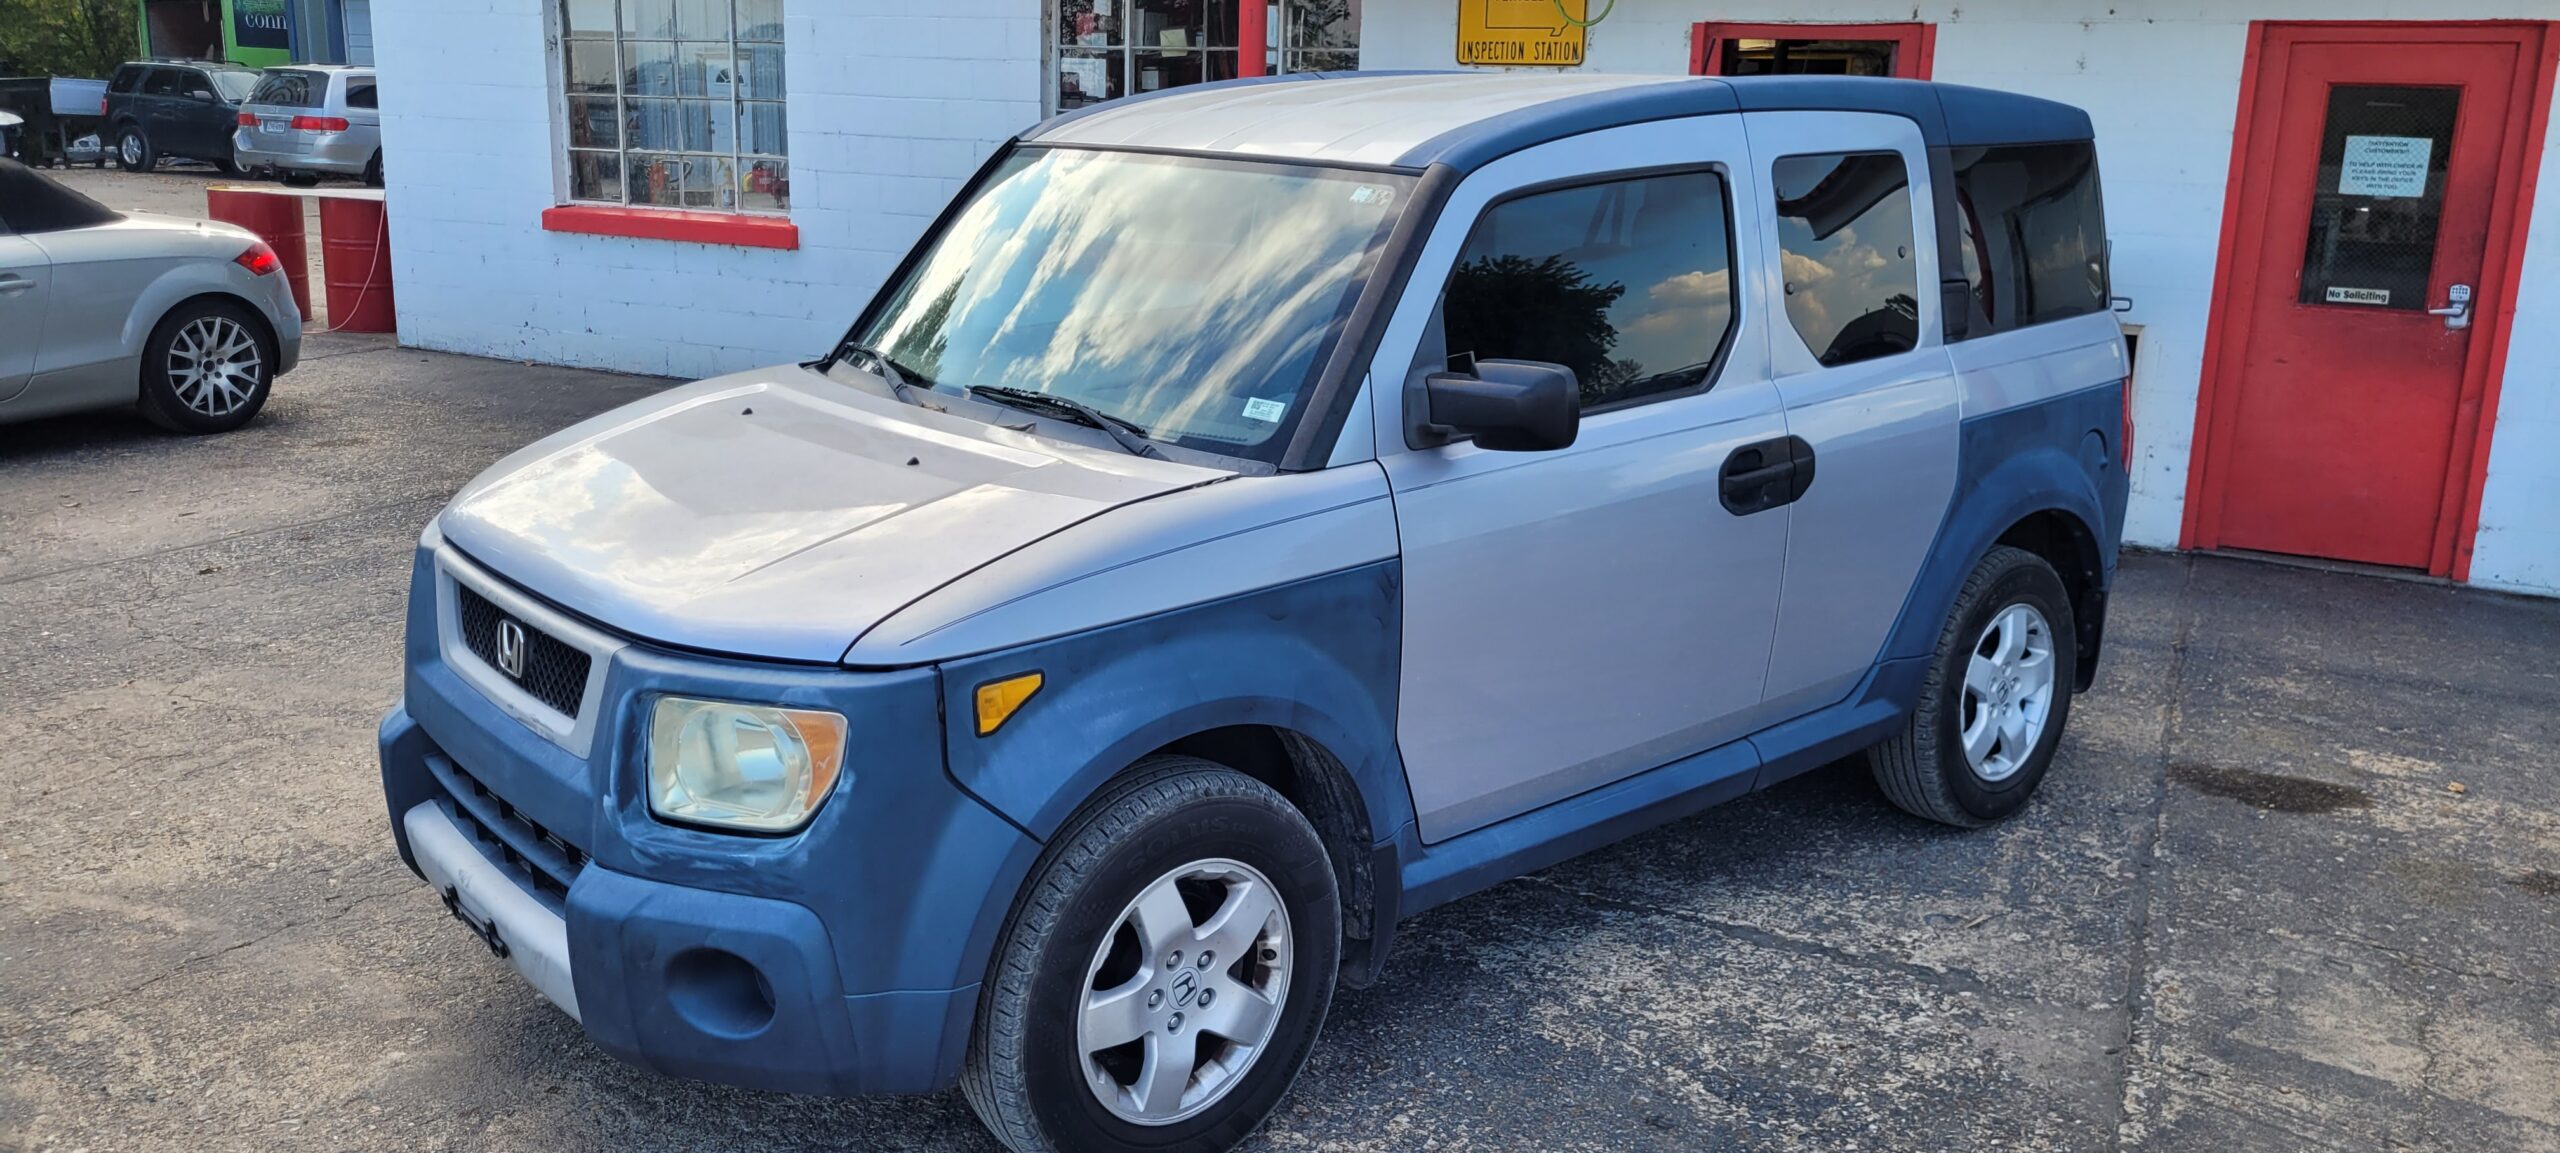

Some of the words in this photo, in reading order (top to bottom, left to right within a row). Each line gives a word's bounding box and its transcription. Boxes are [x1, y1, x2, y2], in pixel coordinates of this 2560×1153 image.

[1462, 41, 1525, 60] INSPECTION
[1534, 41, 1579, 60] STATION
[2328, 289, 2340, 299] No
[2343, 290, 2387, 303] Soliciting
